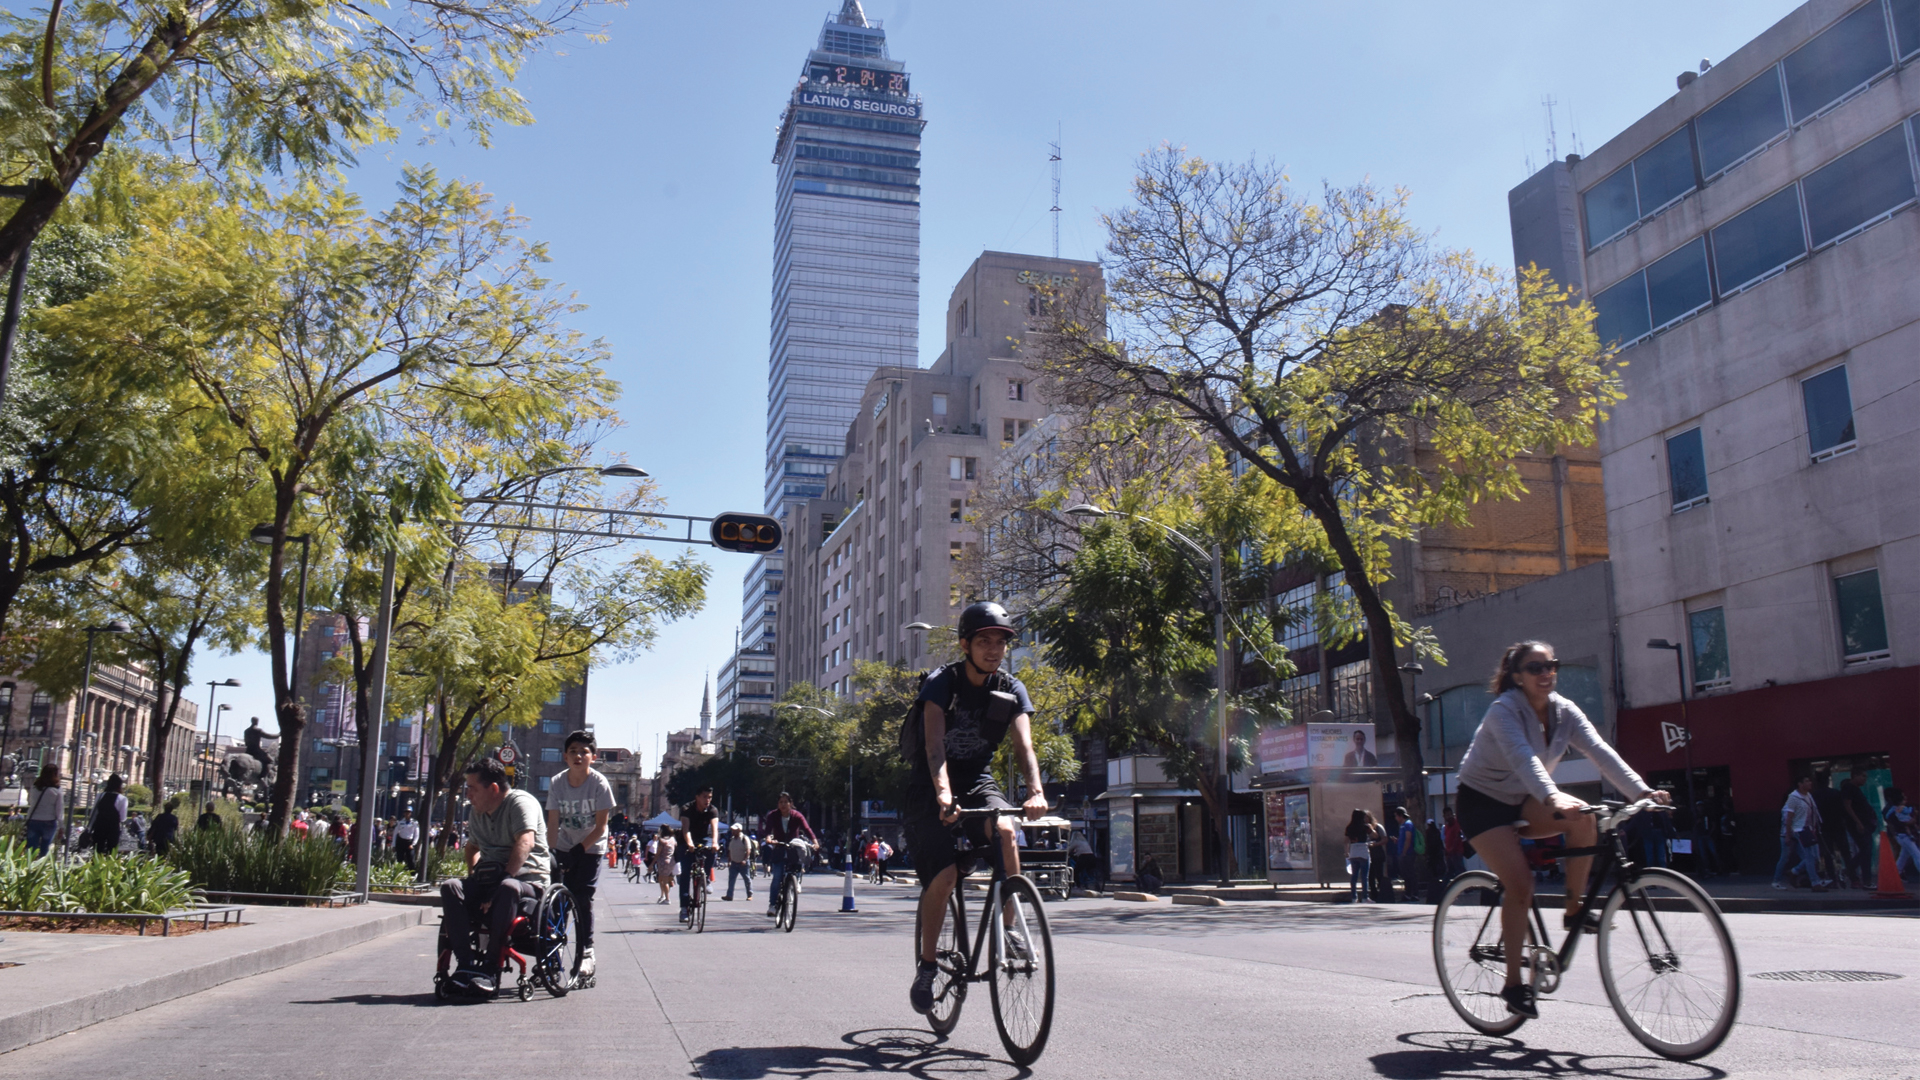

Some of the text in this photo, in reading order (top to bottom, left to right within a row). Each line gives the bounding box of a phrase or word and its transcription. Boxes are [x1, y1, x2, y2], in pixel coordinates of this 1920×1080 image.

[803, 93, 916, 117] LATINO SEGUROS
[1016, 271, 1074, 289] SEARS
[502, 750, 513, 758] 50
